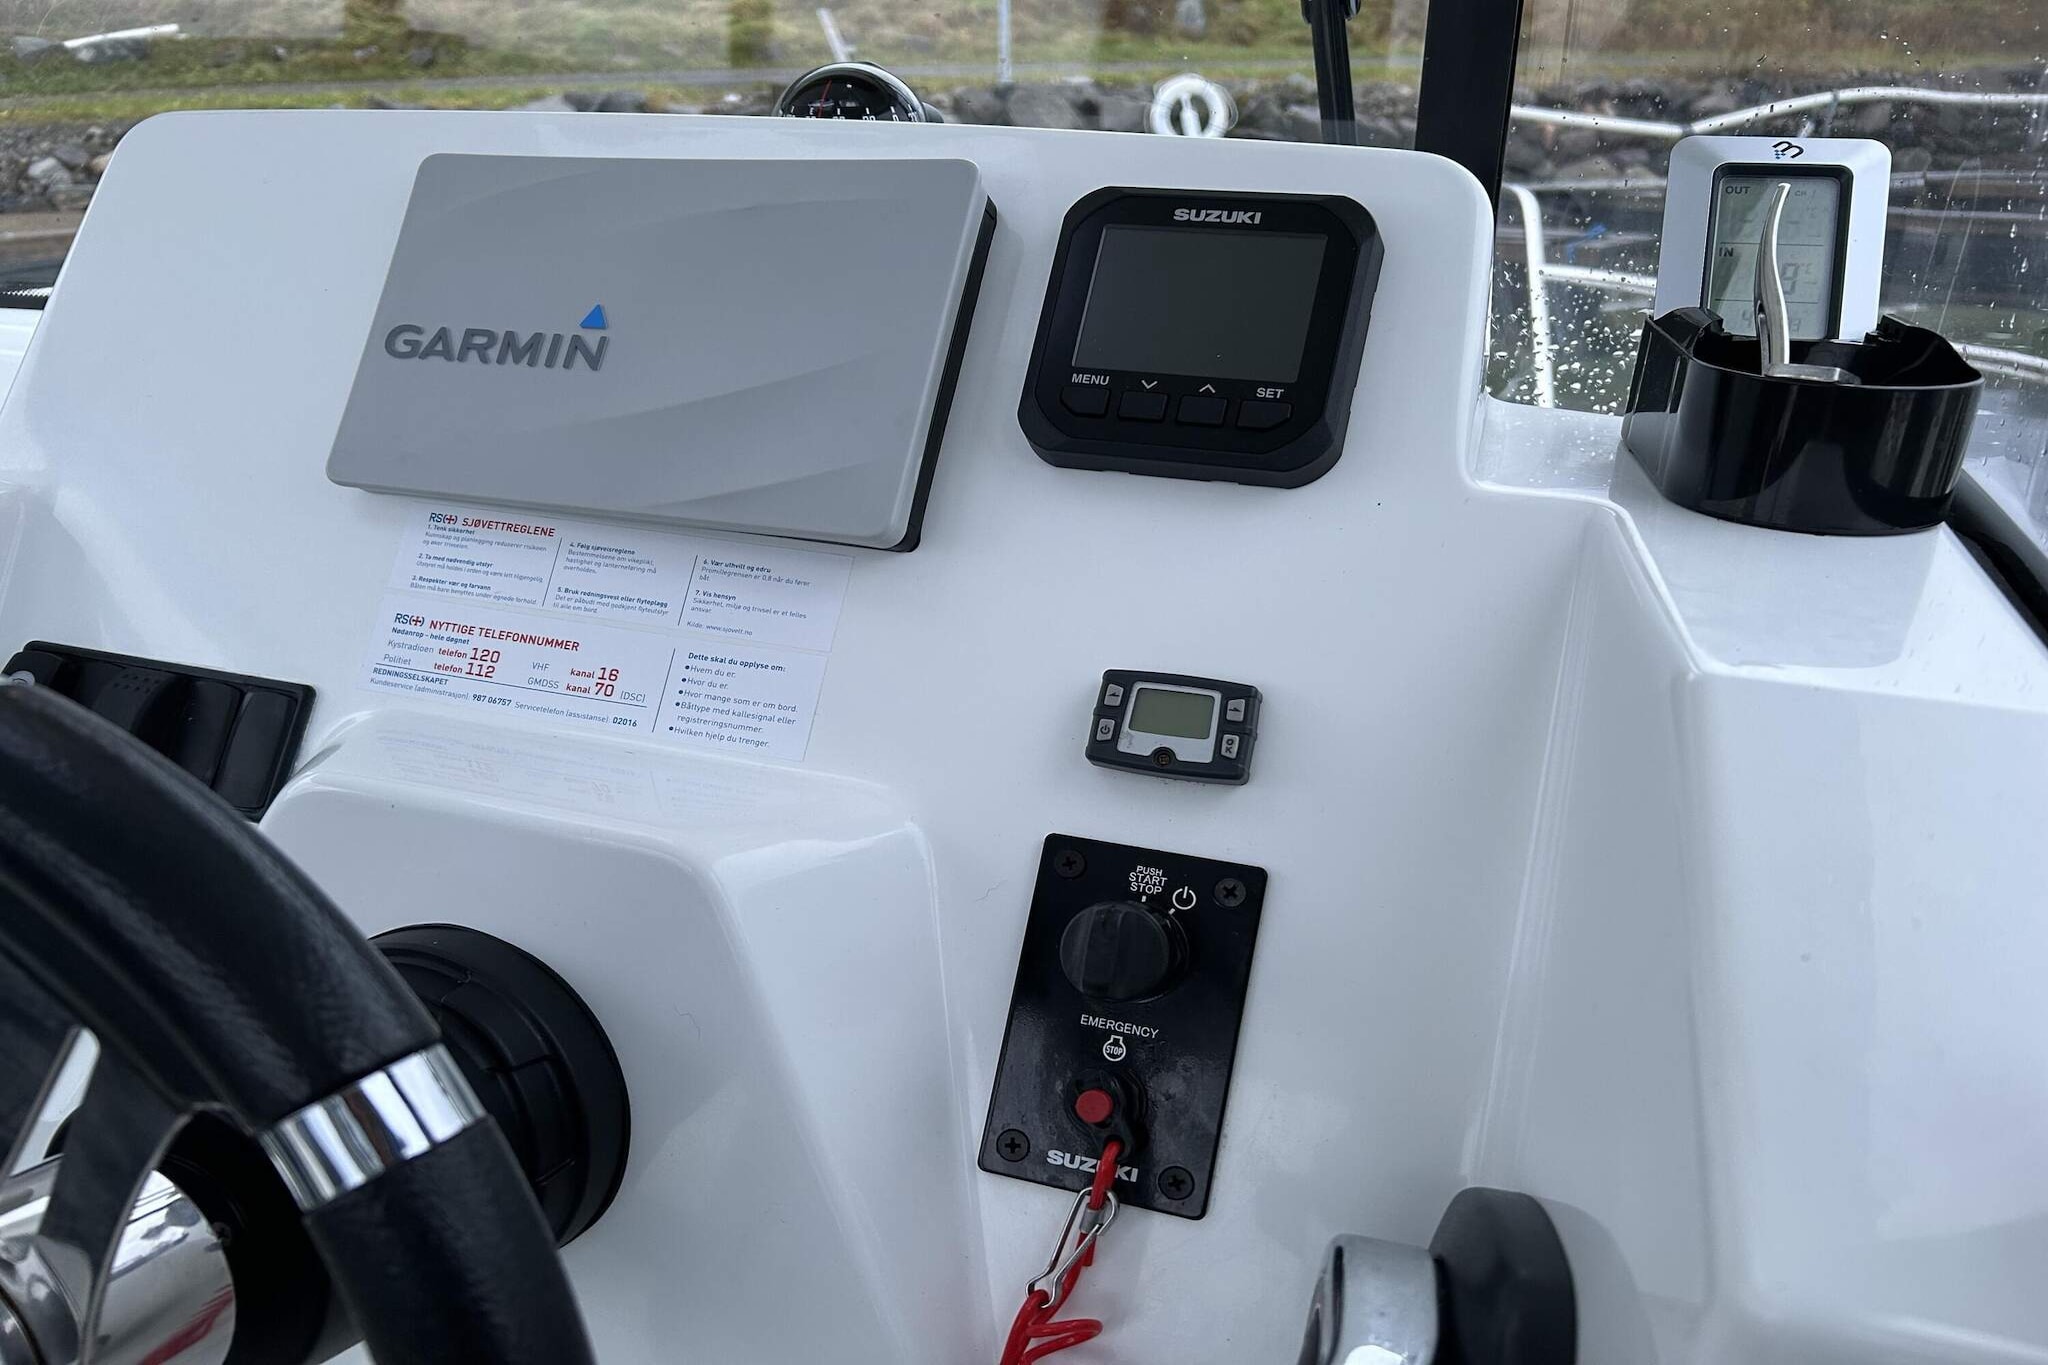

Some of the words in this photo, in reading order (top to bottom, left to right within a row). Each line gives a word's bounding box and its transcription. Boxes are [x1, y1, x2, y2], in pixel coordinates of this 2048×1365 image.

[1725, 185, 1751, 196] OUT
[1173, 208, 1261, 225] SUZUKI
[1719, 247, 1734, 258] IN
[384, 323, 609, 372] GARMIN
[1072, 373, 1110, 386] MENU
[1256, 387, 1284, 400] SET
[462, 517, 556, 537] SJØVETTREGLENE
[576, 542, 590, 551] Følg
[446, 556, 476, 566] nødvendig
[476, 560, 494, 568] utstyr
[568, 549, 616, 561] Bestemmelsene
[602, 562, 645, 574] lanterneføring
[702, 566, 752, 580] Promillegrensen
[724, 560, 745, 570] uthvilt
[755, 565, 771, 573] edru
[418, 575, 448, 585] Respekter
[468, 582, 492, 590] farvann
[574, 596, 595, 606] påbudt
[596, 600, 610, 608] med
[610, 602, 636, 612] godkjent
[580, 590, 620, 602] redningsvest
[620, 594, 636, 602] eller
[636, 596, 668, 608] flyteplagg
[714, 592, 736, 601] hensyn
[752, 606, 772, 615] trivsel
[392, 626, 424, 638] Nødanrop
[446, 636, 470, 645] døgnet
[429, 620, 476, 636] NYTTIGE
[479, 627, 580, 652] TELEFONNUMMER
[388, 640, 434, 654] Kystradioen
[438, 648, 468, 659] telefon
[470, 647, 501, 663] 120
[384, 654, 412, 666] Politiet
[434, 663, 462, 674] telefon
[465, 662, 496, 678] 112
[688, 652, 708, 662] Dette
[710, 656, 726, 664] skal
[740, 660, 769, 670] opplyse
[372, 667, 448, 686] REDNINGSSELSKAPET
[532, 662, 550, 671] VHF
[570, 668, 594, 678] kanal
[598, 667, 619, 682] 16
[690, 665, 712, 675] Hvem
[528, 676, 559, 689] GMDSS
[566, 683, 590, 694] kanal
[595, 682, 614, 697] 70
[687, 678, 705, 686] Hvor
[370, 677, 414, 690] Kundeservice
[472, 694, 486, 702] 987
[488, 695, 512, 706] 06757
[514, 702, 564, 716] Servicetelefon
[612, 716, 638, 728] 02016
[684, 690, 702, 698] Hvor
[704, 693, 732, 704] mange
[778, 703, 798, 712] bord.
[680, 702, 710, 713] Båttype
[712, 707, 730, 716] med
[732, 710, 776, 722] kallesignal
[777, 716, 796, 725] eller
[677, 714, 763, 733] registreringsnummer.
[674, 726, 704, 737] Hvilken
[705, 731, 724, 741] hjelp
[726, 734, 736, 742] du
[738, 736, 770, 748] trenger.
[1136, 865, 1162, 876] PUSH
[1129, 872, 1168, 886] START
[1130, 882, 1162, 894] STOP
[1080, 1014, 1160, 1038] EMERGENCY
[1105, 1044, 1123, 1056] STOP
[1046, 1150, 1139, 1182] SUZKI
